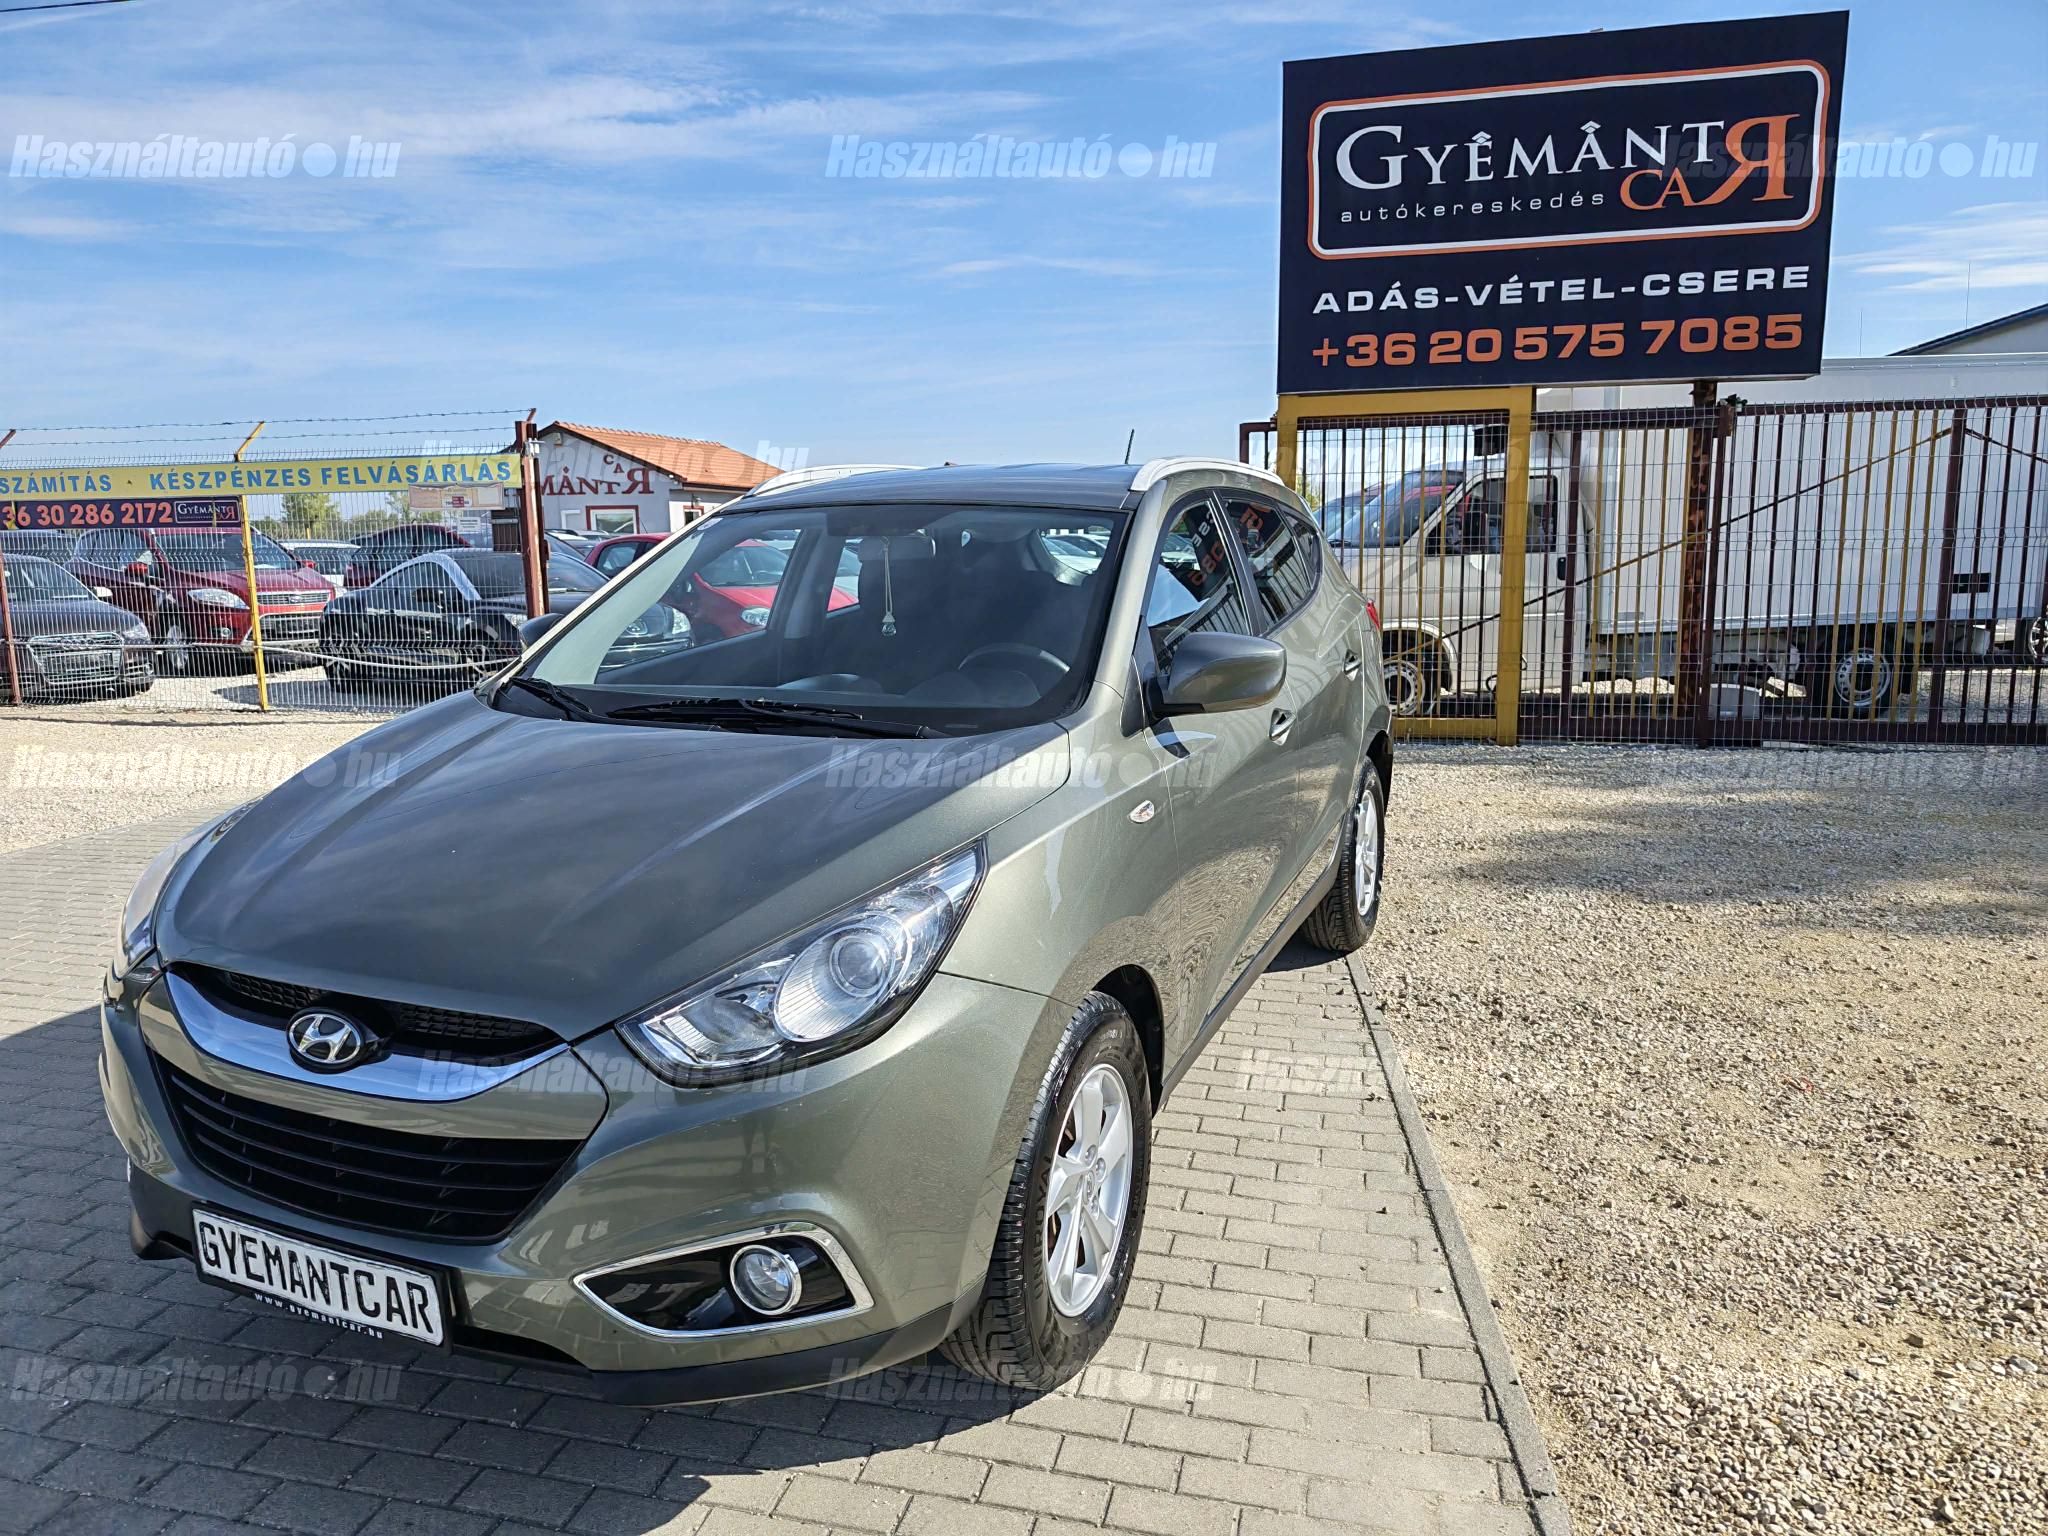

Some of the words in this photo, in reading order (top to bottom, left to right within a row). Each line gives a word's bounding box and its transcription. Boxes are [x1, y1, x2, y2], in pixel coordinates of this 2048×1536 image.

[1341, 191, 1604, 222] autókereskedés
[1312, 265, 1810, 314] ADÁS-VÉTEL-CSERE
[1312, 332, 1416, 368] +36
[1429, 328, 1502, 364] 20
[1513, 322, 1625, 361] 575
[1640, 313, 1803, 355] 7085
[150, 466, 311, 490] KÉSZPÉNZES
[320, 460, 511, 486] FELVÁSÁRLÁS
[37, 504, 65, 526] 30
[71, 503, 115, 525] 286
[120, 501, 174, 524] 2172
[199, 1221, 434, 1334] GYEMANTCAR
